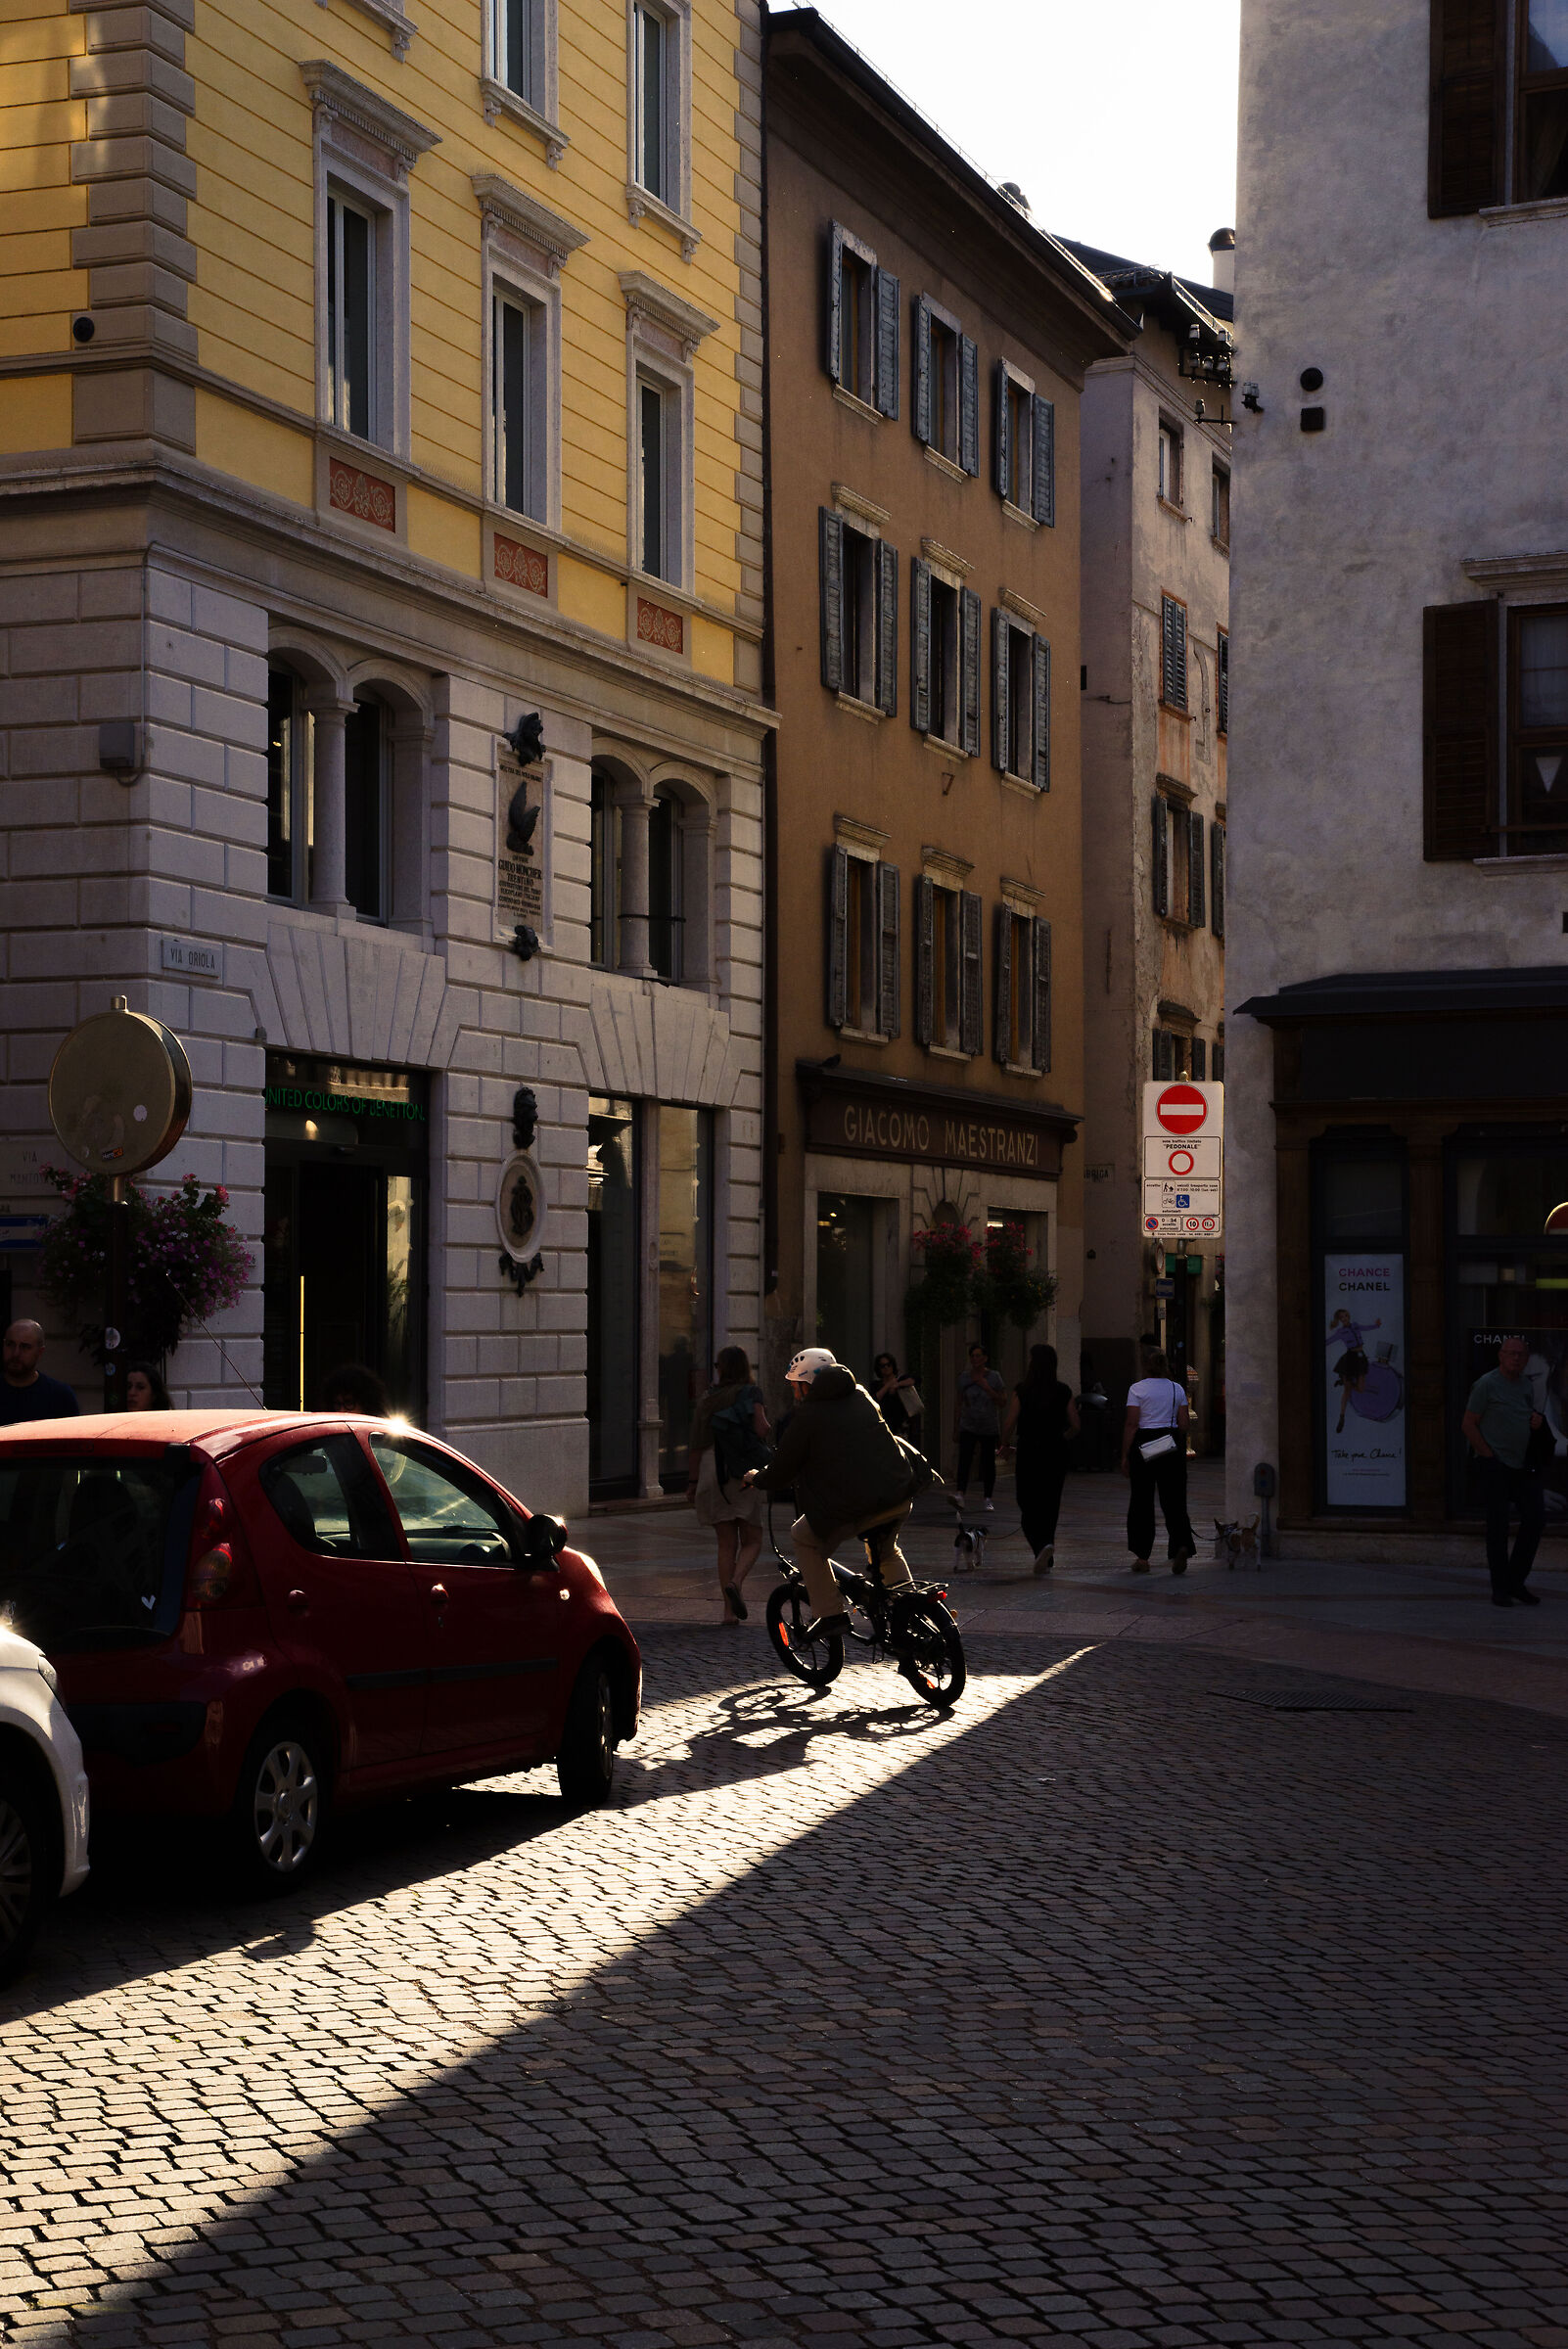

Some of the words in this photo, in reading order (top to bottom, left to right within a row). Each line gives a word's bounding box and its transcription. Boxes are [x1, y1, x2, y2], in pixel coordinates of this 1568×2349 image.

[498, 859, 516, 873] GUIDO
[516, 863, 542, 880] MONCHER
[507, 872, 534, 888] TRENTINO
[170, 947, 183, 964] VIA
[188, 951, 215, 969] ORIOLA
[304, 1090, 349, 1113] COLORS
[352, 1096, 369, 1115] OF
[844, 1105, 930, 1151] GIACOMO
[944, 1119, 1038, 1166] MAESTRANZI
[23, 1151, 38, 1163] VIA
[1338, 1268, 1391, 1277] CHANCE
[1338, 1282, 1391, 1291] CHANEL
[1331, 1449, 1349, 1458] Take
